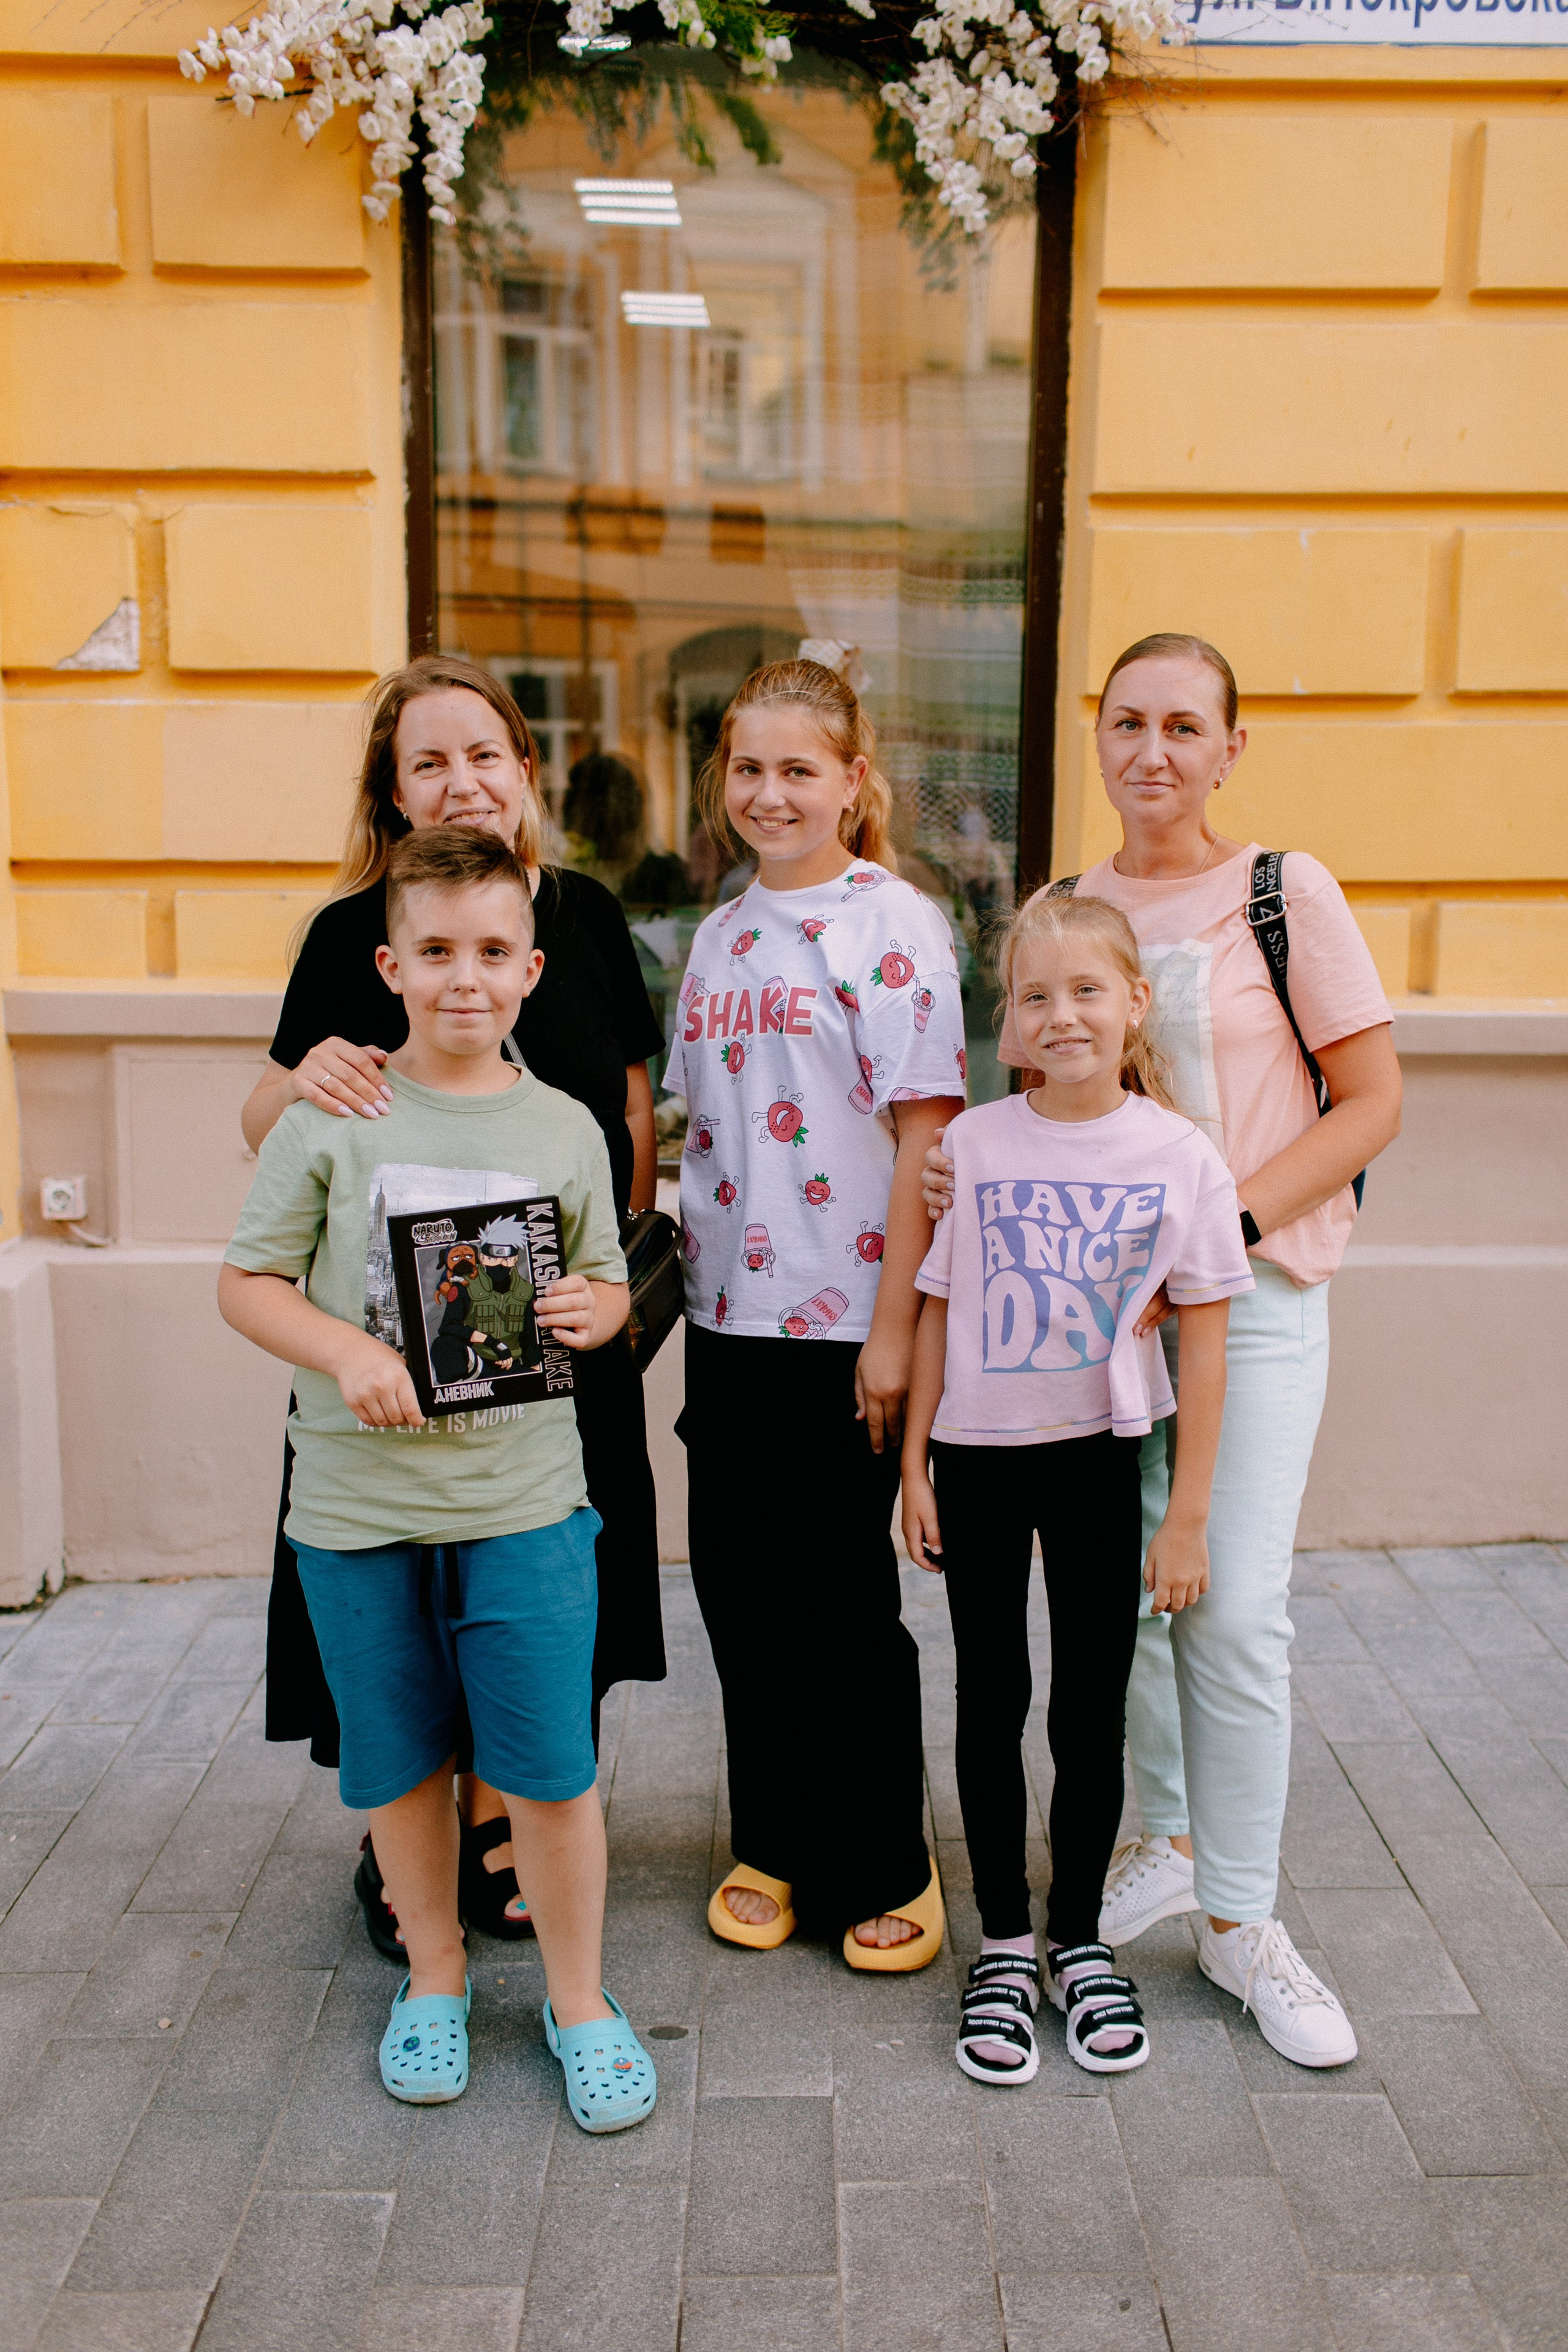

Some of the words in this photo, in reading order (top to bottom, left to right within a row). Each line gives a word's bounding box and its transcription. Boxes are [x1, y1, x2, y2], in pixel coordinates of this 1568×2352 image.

[1255, 866, 1265, 891] LOS
[1267, 853, 1281, 892] NGELES
[1267, 930, 1287, 977] ESS
[684, 987, 818, 1042] SHAKE
[981, 1182, 1161, 1234] HAVE
[413, 1222, 453, 1237] NARUTO
[982, 1226, 1016, 1279] A
[1018, 1220, 1150, 1282] NICE
[434, 1381, 495, 1404] ДНЕВНИК
[447, 1413, 466, 1433] IS
[472, 1403, 526, 1431] MOVIE
[1000, 2022, 1015, 2031] ONLY
